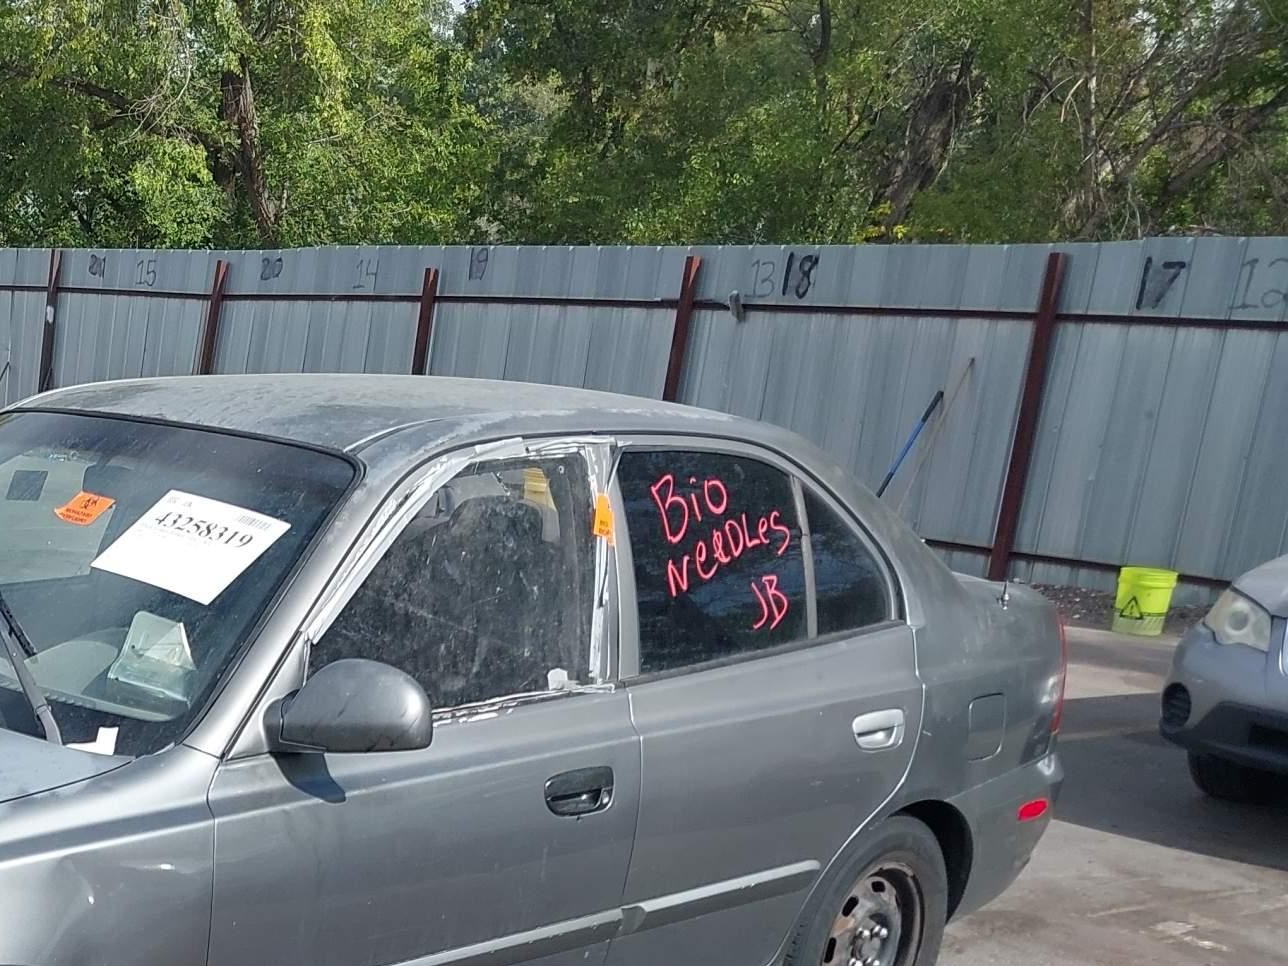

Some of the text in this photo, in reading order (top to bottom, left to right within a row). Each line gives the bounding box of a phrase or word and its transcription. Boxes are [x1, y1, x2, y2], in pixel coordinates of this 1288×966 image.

[135, 259, 158, 287] 15
[352, 259, 380, 292] 14
[744, 258, 775, 298] 13
[781, 250, 820, 300] 18
[1135, 256, 1187, 310] 17
[154, 511, 254, 549] 43258319
[750, 574, 789, 631] JB
